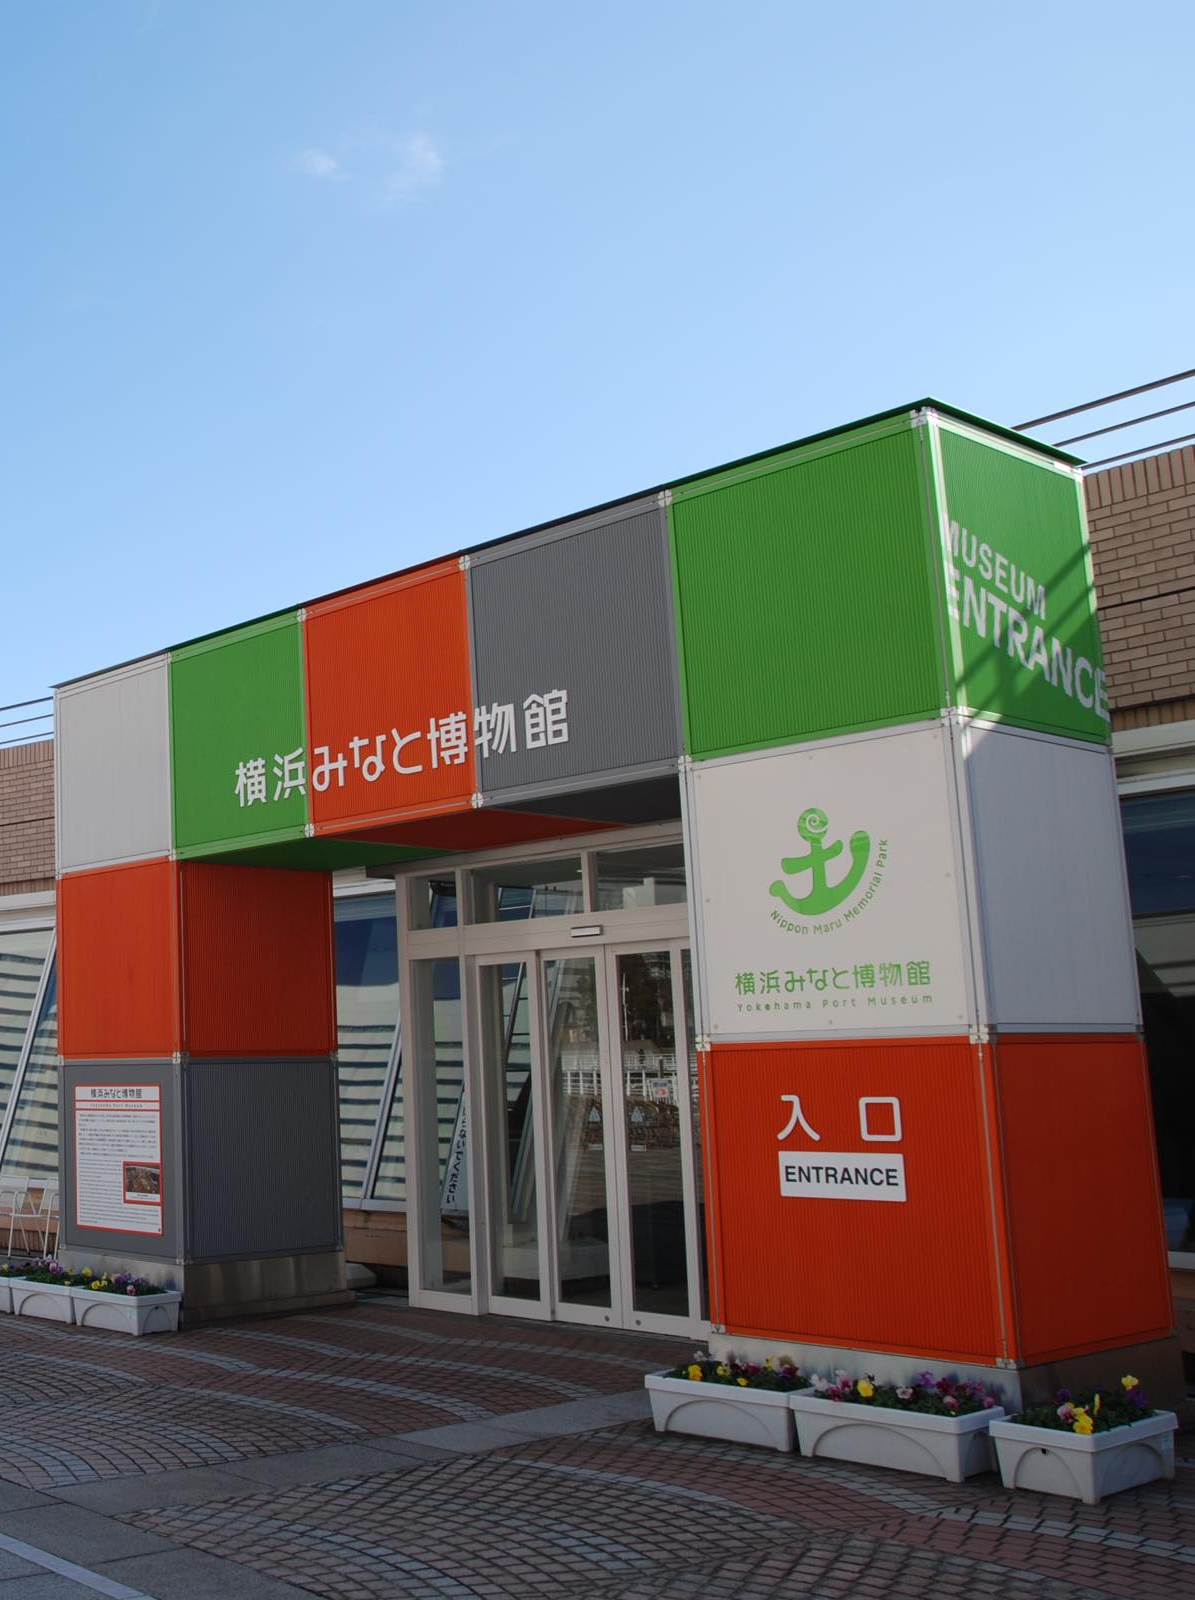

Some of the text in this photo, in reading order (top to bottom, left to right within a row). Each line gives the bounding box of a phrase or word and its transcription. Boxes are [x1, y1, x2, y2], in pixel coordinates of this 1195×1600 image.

[948, 566, 1110, 722] ENTRANCE
[235, 689, 569, 807] 横浜みなと博物館
[770, 839, 888, 935] Nippon Maru Memorial Park
[735, 960, 931, 995] 横浜みなと博物館
[822, 999, 856, 1009] Port
[868, 995, 933, 1006] Museum
[777, 1094, 902, 1142] 入口
[785, 1165, 899, 1187] ENTRANCE
